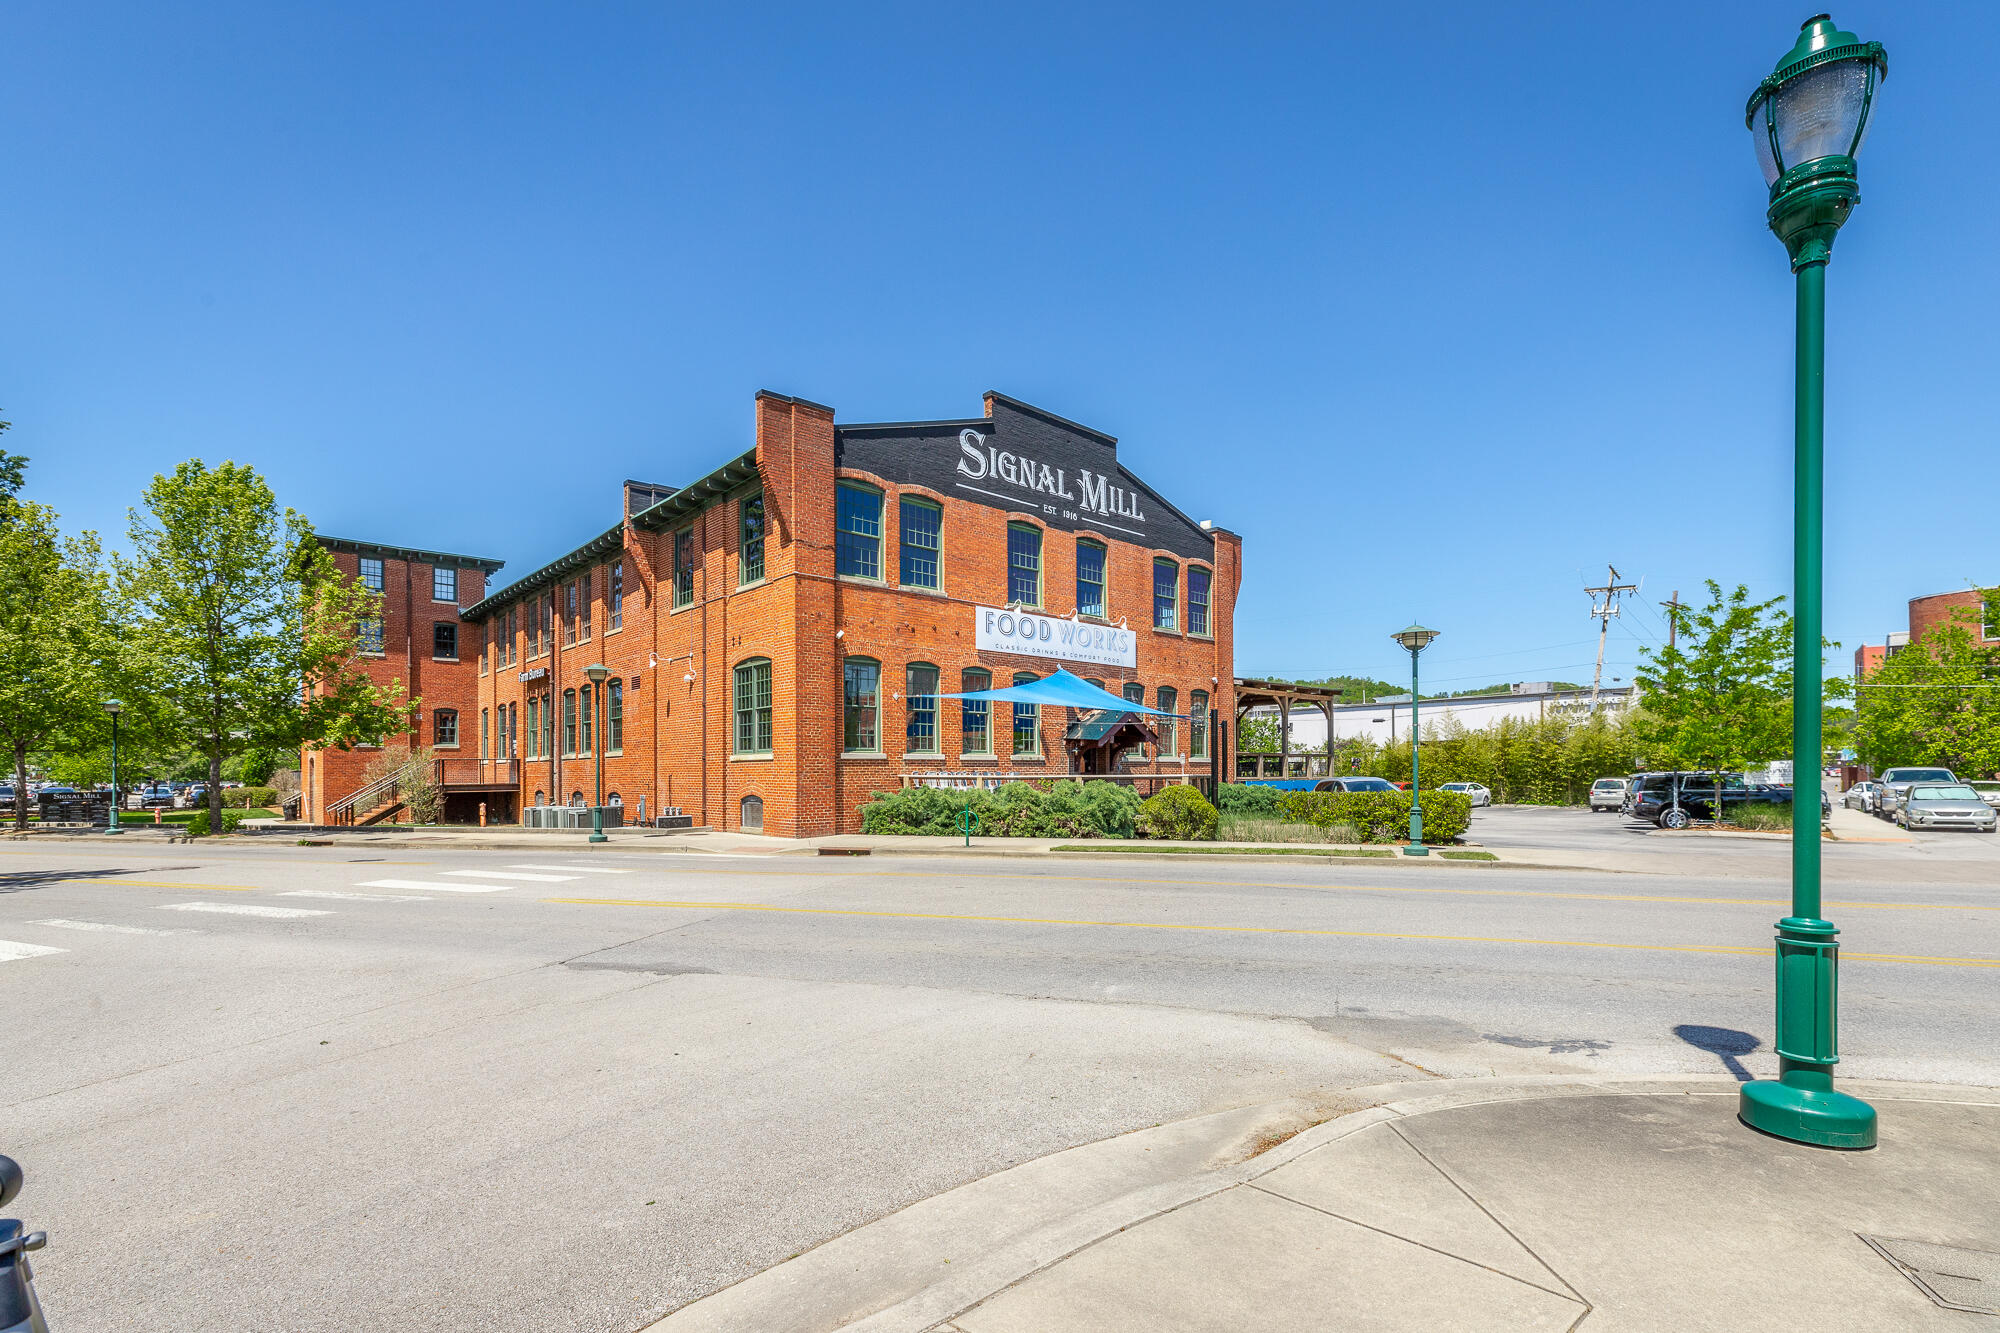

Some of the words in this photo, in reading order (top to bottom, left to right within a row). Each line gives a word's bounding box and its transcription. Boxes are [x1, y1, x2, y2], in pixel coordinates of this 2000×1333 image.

[957, 428, 1074, 500] SIGNAL
[1076, 468, 1146, 521] MILL
[985, 611, 1051, 641] FOOD
[1057, 621, 1129, 653] WORKS
[995, 643, 1028, 653] CLASSIC
[1032, 648, 1059, 656] DRINKS
[1069, 652, 1100, 661] COMFORT
[1104, 656, 1120, 664] FOOD
